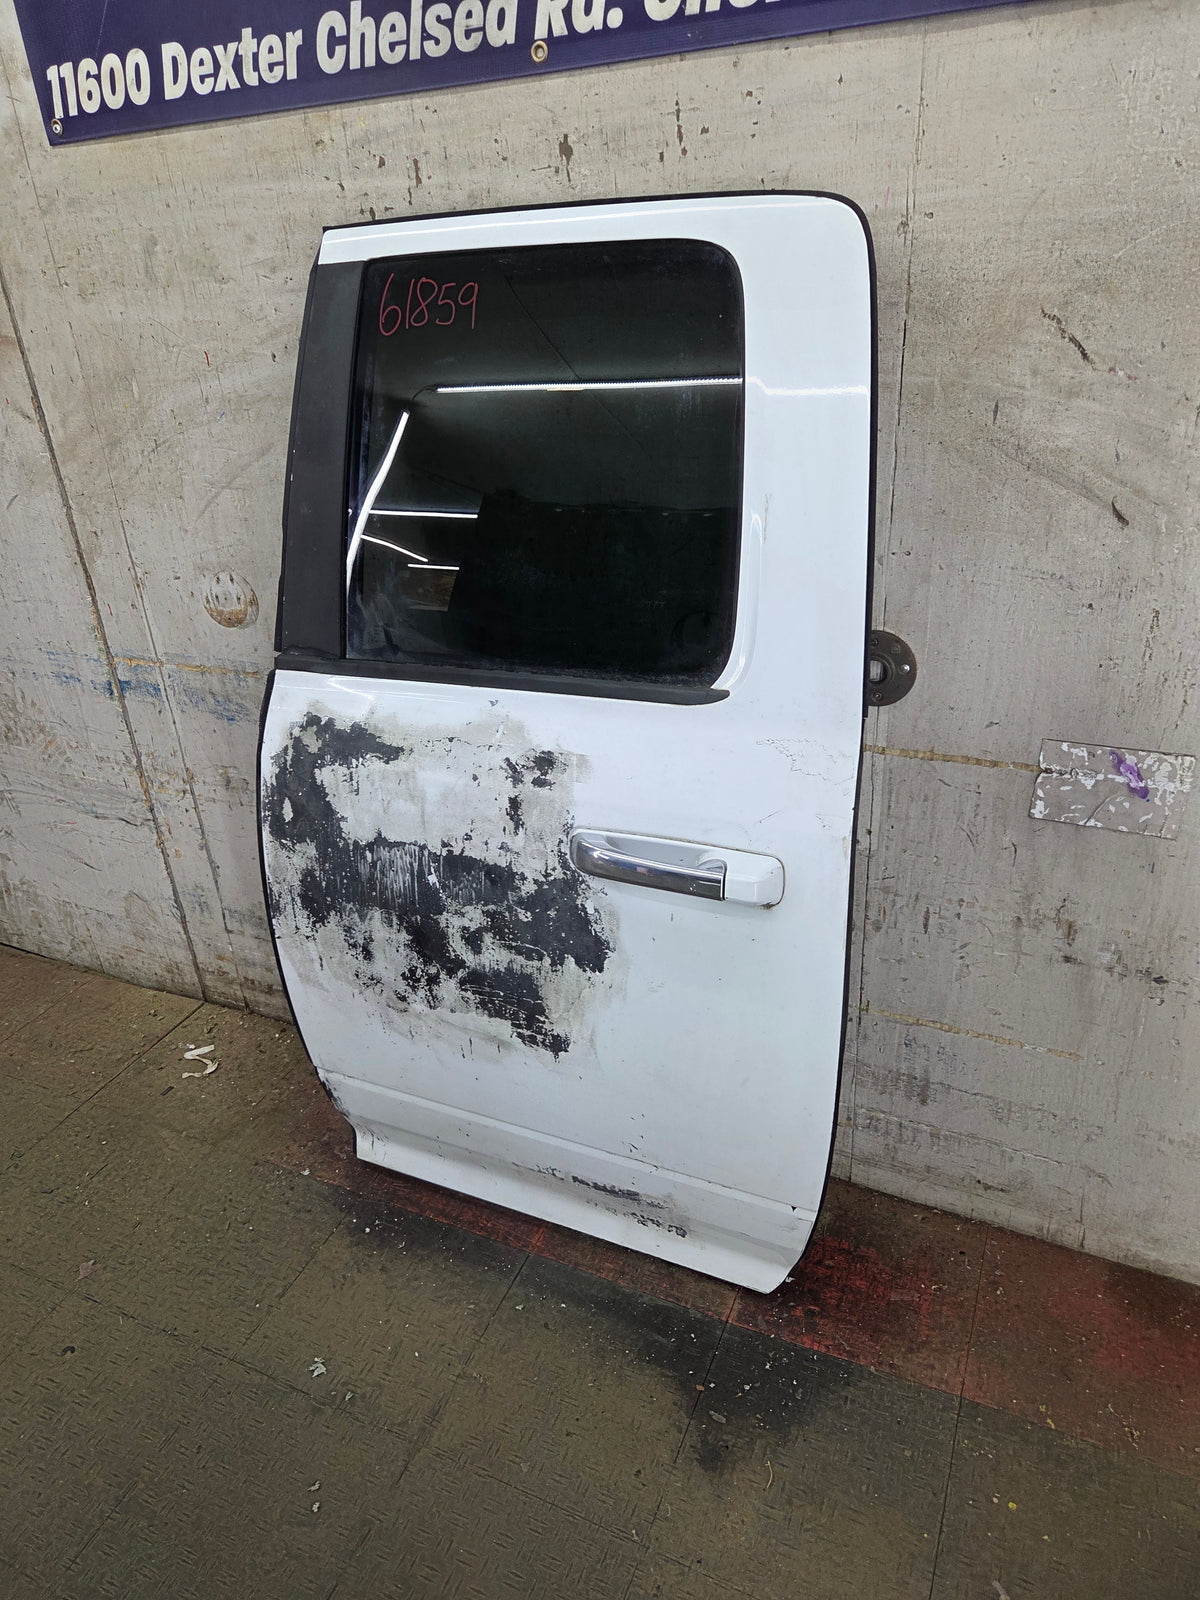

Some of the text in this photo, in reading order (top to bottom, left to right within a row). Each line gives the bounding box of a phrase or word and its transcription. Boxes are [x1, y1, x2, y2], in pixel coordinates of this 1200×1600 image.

[46, 47, 151, 119] 11600
[161, 26, 303, 101] Dexter
[316, 0, 519, 75] Chelsea
[379, 272, 479, 337] 61859
